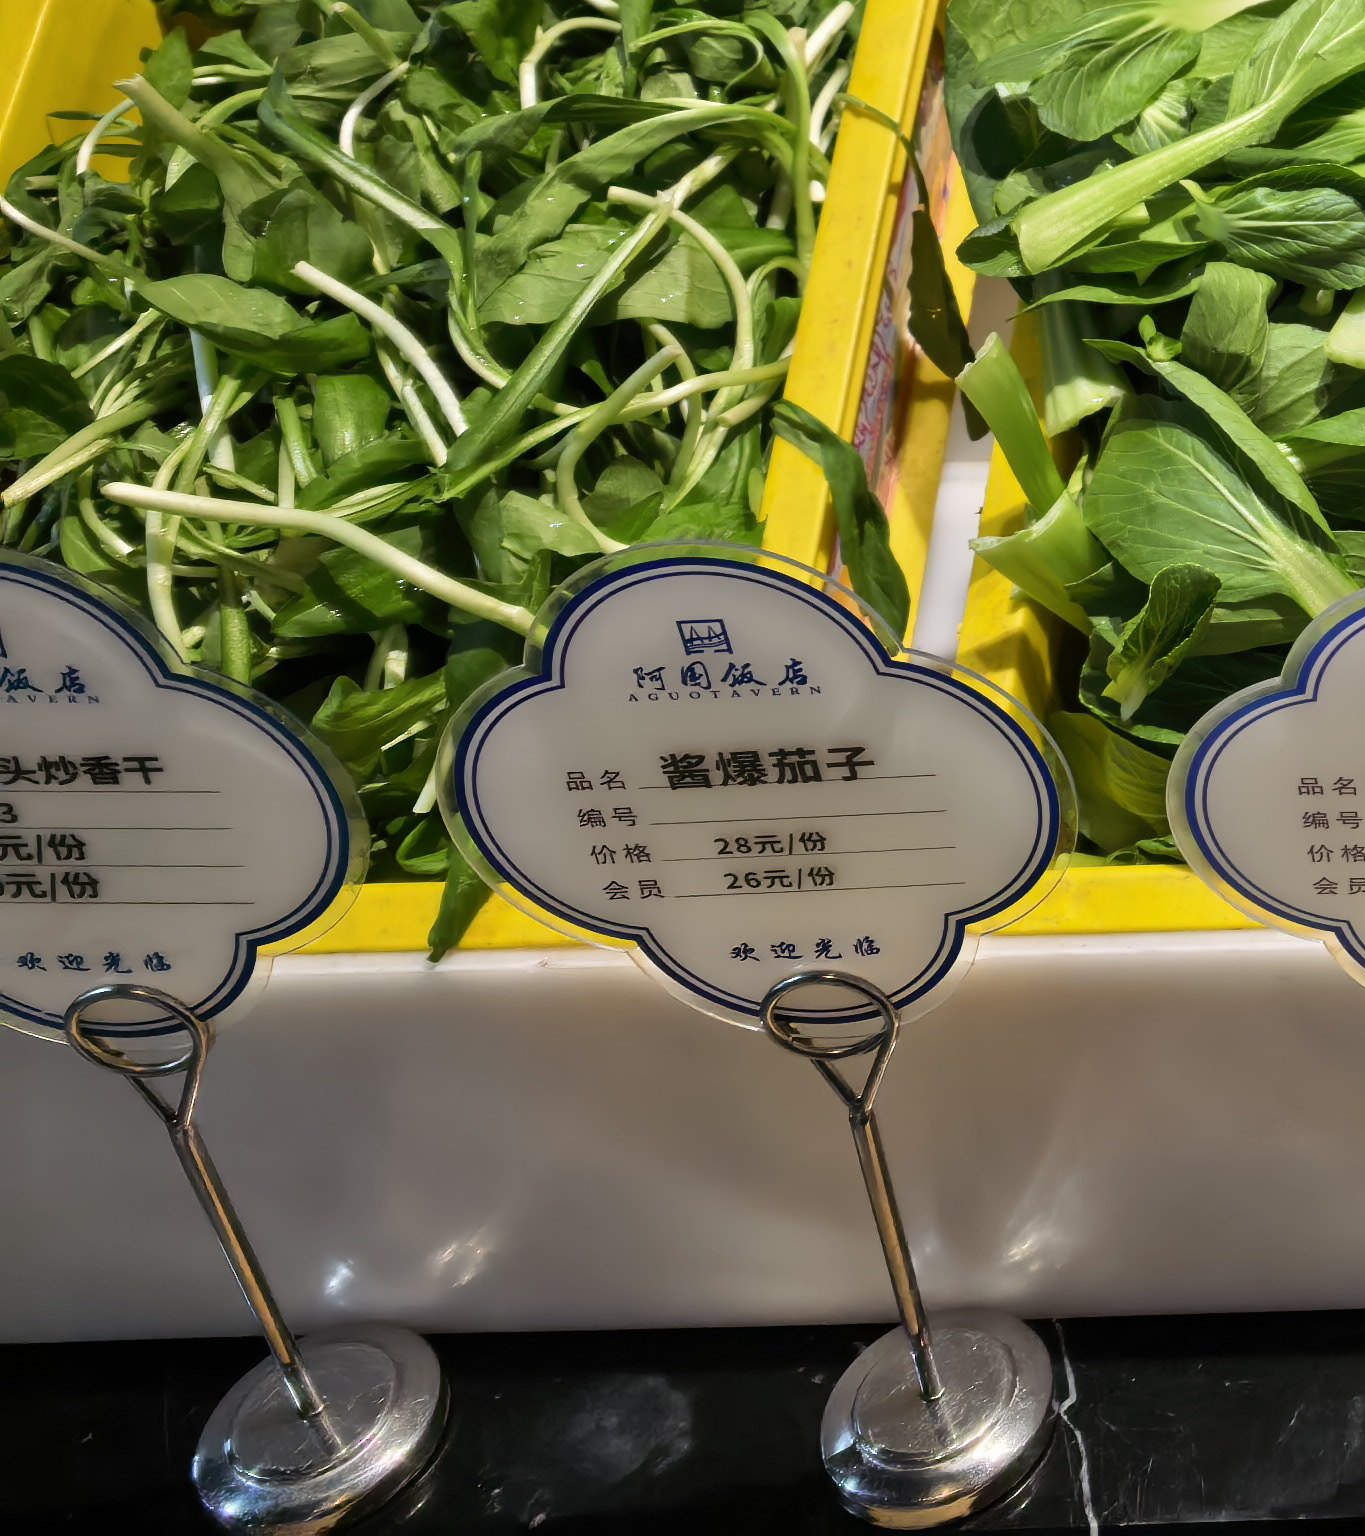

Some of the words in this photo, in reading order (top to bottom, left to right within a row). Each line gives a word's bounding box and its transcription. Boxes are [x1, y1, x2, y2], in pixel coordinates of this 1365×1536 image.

[0, 755, 164, 786] 头炒香干
[566, 769, 628, 791] 品名
[659, 746, 876, 791] 酱爆茄子
[1297, 776, 1360, 796] 品名
[576, 807, 639, 828] 编号
[1302, 810, 1364, 830] 编号
[590, 842, 654, 865] 价格
[713, 832, 828, 858] 28元/份
[0, 871, 100, 902] 元/份
[602, 878, 666, 900] 会员
[723, 866, 836, 891] 26元/份
[19, 952, 172, 974] 欢迎光临
[729, 936, 881, 962] 欢迎光临
